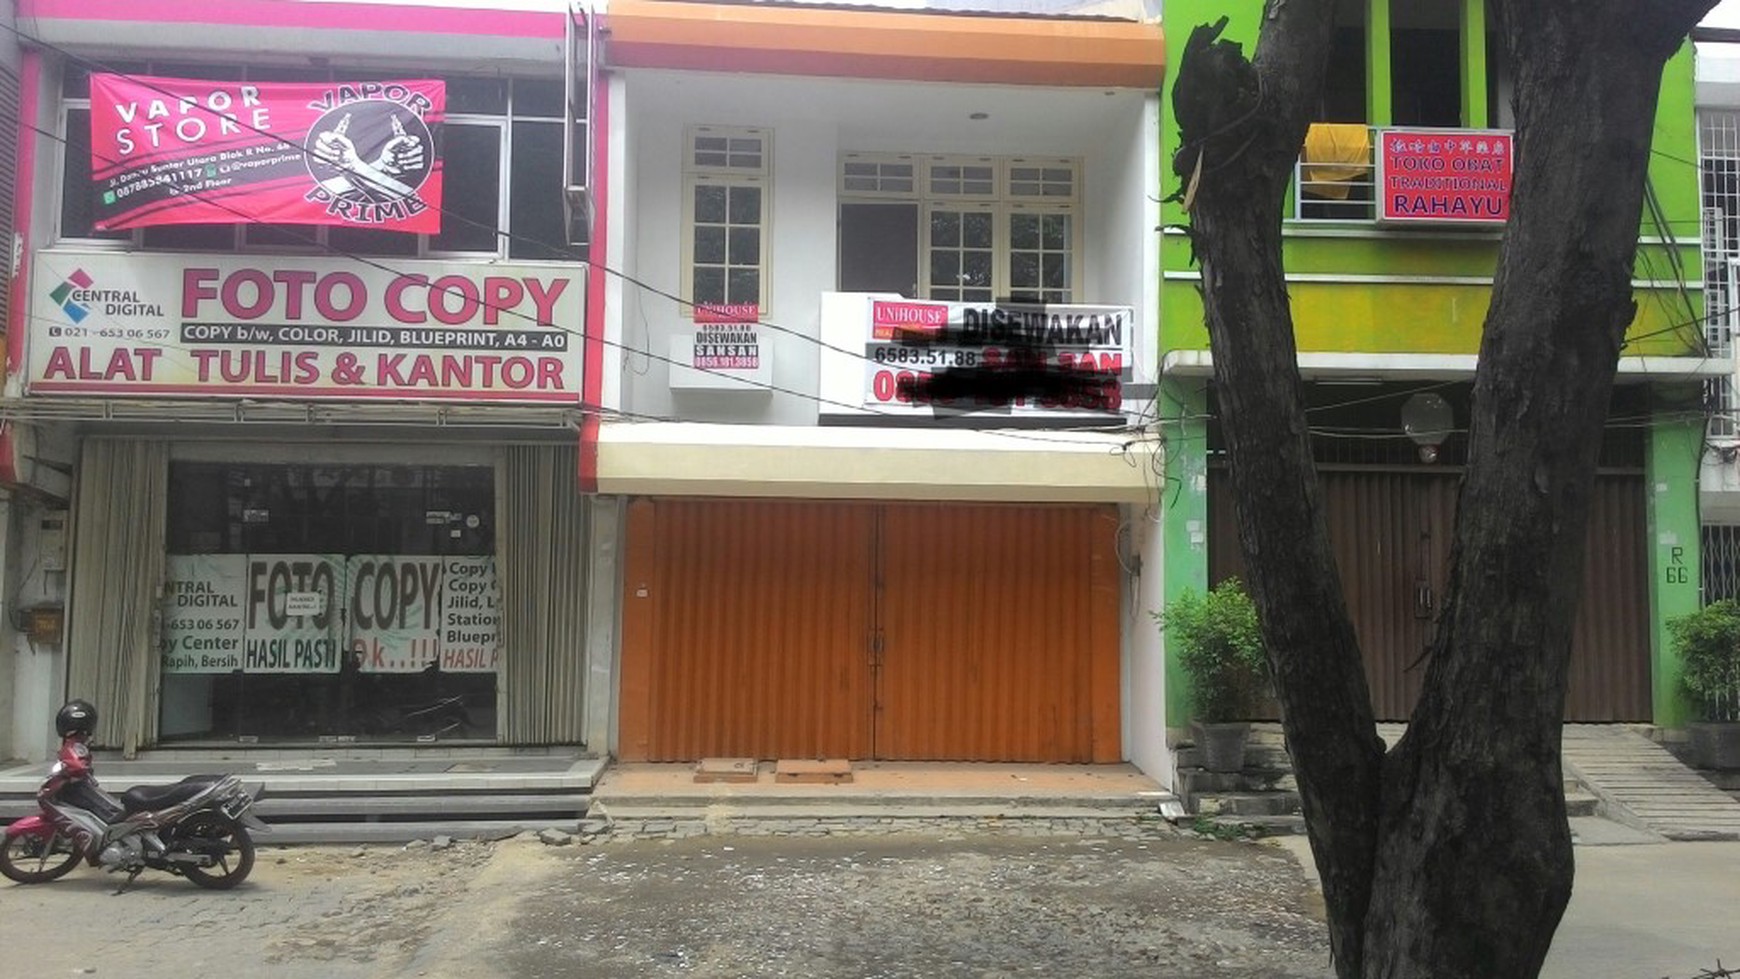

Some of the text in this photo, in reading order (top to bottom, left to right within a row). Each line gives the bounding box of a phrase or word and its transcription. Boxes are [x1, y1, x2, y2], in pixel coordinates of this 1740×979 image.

[115, 86, 262, 124] VAPOR
[306, 81, 433, 118] VAPOR
[116, 108, 271, 155] STORE
[151, 161, 184, 173] Sunter
[187, 155, 217, 166] Utara
[220, 149, 244, 160] Blok
[245, 147, 253, 156] R
[255, 145, 275, 154] No.
[1390, 156, 1505, 172] TOKO OBAT
[183, 181, 203, 193] 2nd
[205, 178, 233, 188] Floor
[1390, 175, 1507, 192] TRADITIONAL
[304, 185, 428, 224] PRIME
[1394, 194, 1503, 215] RAHAYU
[71, 289, 141, 303] CENTRAL
[181, 267, 571, 328] FOTO COPY
[105, 303, 165, 317] DIGITAL
[64, 327, 88, 337] 021
[126, 328, 144, 338] 06
[147, 329, 170, 339] 567
[962, 307, 1123, 346] DISEWAKAN
[184, 325, 234, 340] COPY
[236, 326, 275, 342] b/w,
[278, 327, 344, 344] COLOR,
[347, 329, 396, 345] JILID,
[400, 331, 500, 348] BLUEPRINT,
[504, 336, 528, 347] A4
[541, 336, 566, 348] A0
[696, 331, 757, 344] DISEWAKAN
[874, 346, 976, 367] 6583.51.88
[43, 346, 565, 390] ALAT TULIS & KANTOR
[1671, 546, 1684, 565] R
[449, 562, 488, 577] Copy
[1666, 566, 1689, 584] 66
[248, 560, 441, 631] FOTO COPY
[448, 579, 487, 595] Copy
[177, 594, 239, 608] DIGITAL
[447, 595, 483, 611] Jilid,
[196, 619, 214, 630] 06
[216, 619, 240, 631] 567
[182, 635, 239, 650] Center
[201, 653, 239, 668] Bersih
[246, 638, 290, 669] HASIL
[294, 638, 336, 669] PASTI
[442, 647, 487, 669] HASIL
